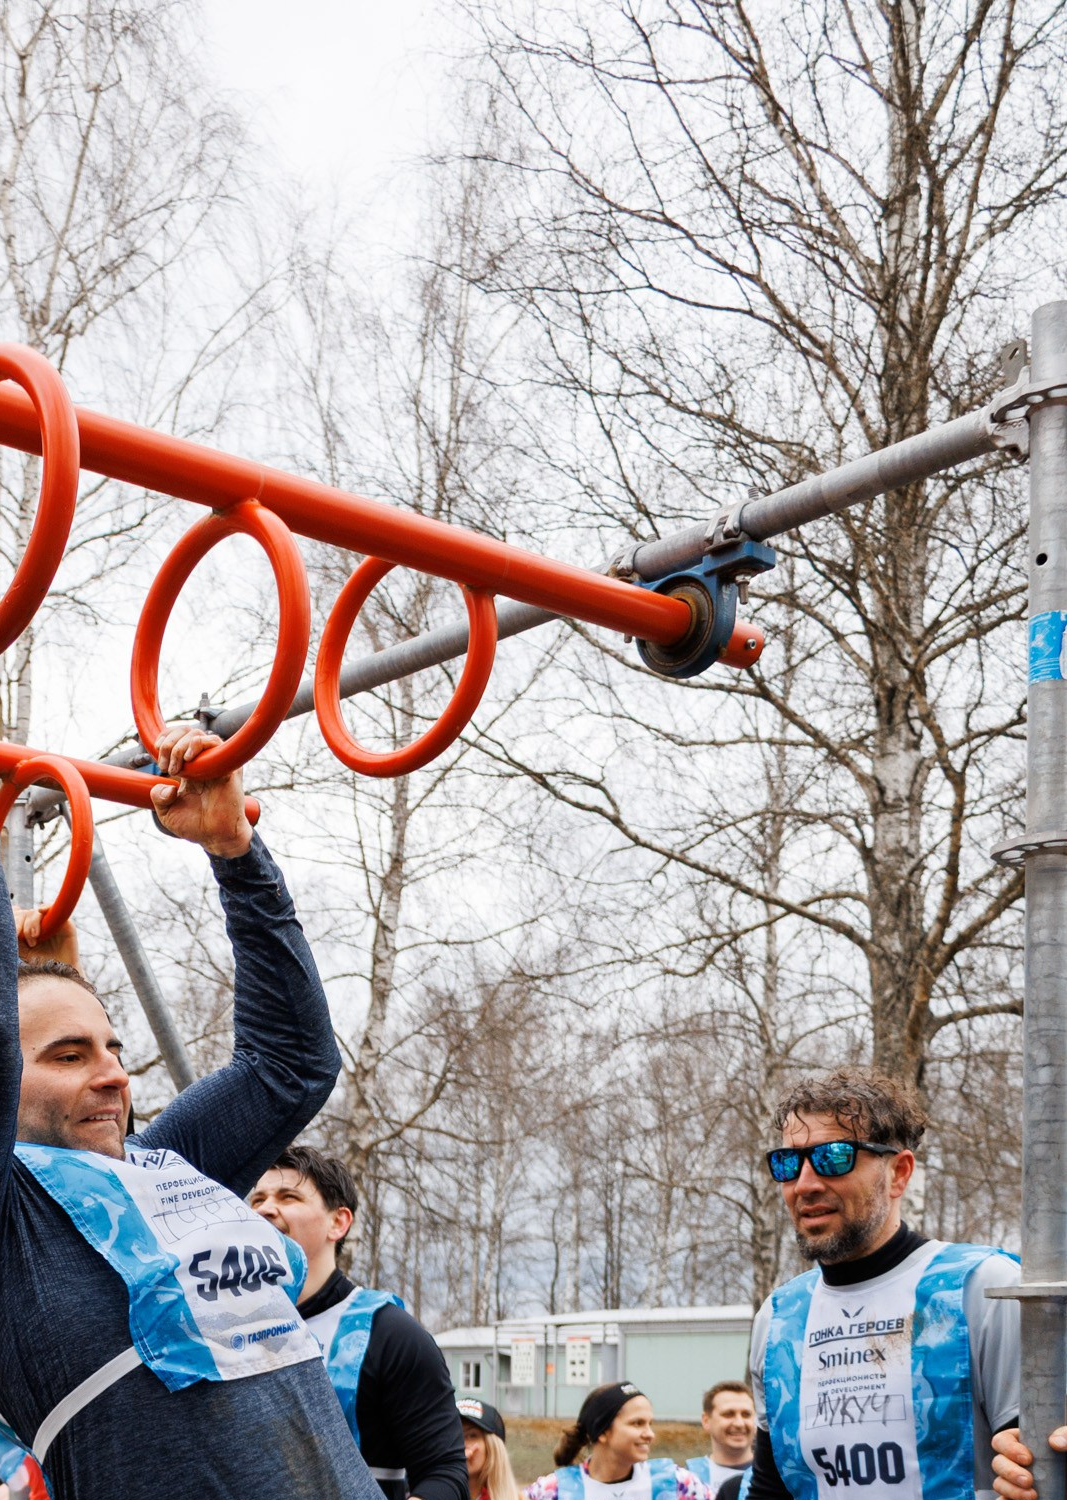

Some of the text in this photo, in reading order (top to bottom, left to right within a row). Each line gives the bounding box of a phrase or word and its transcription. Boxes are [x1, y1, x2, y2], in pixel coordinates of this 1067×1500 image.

[160, 1194, 179, 1206] FINE
[248, 1320, 301, 1344] ГАЗПРОМБАНК
[809, 1318, 905, 1343] ГОНКА ГЕРОЕВ
[818, 1347, 887, 1371] Sminex
[830, 1383, 886, 1395] DEVELOPMENT
[811, 1441, 906, 1487] 5400
